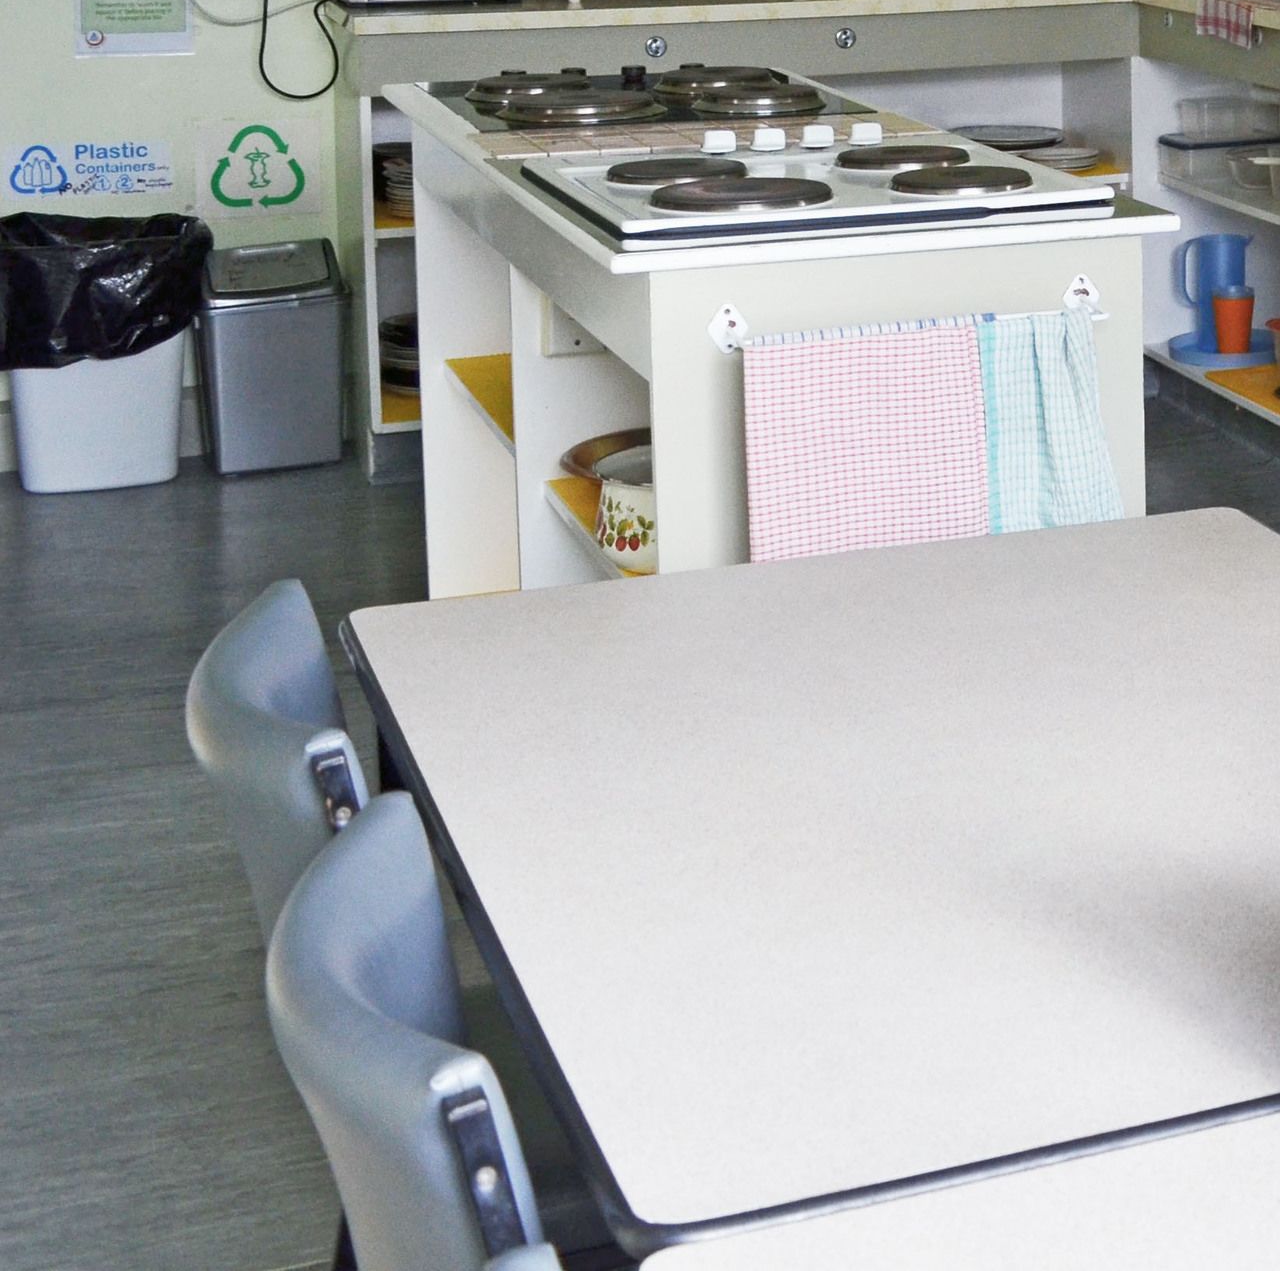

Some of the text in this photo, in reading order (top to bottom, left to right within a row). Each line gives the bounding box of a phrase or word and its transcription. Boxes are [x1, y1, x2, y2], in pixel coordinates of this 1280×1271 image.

[74, 142, 148, 160] Plastic
[75, 162, 156, 175] Containers
[120, 177, 129, 187] 2
